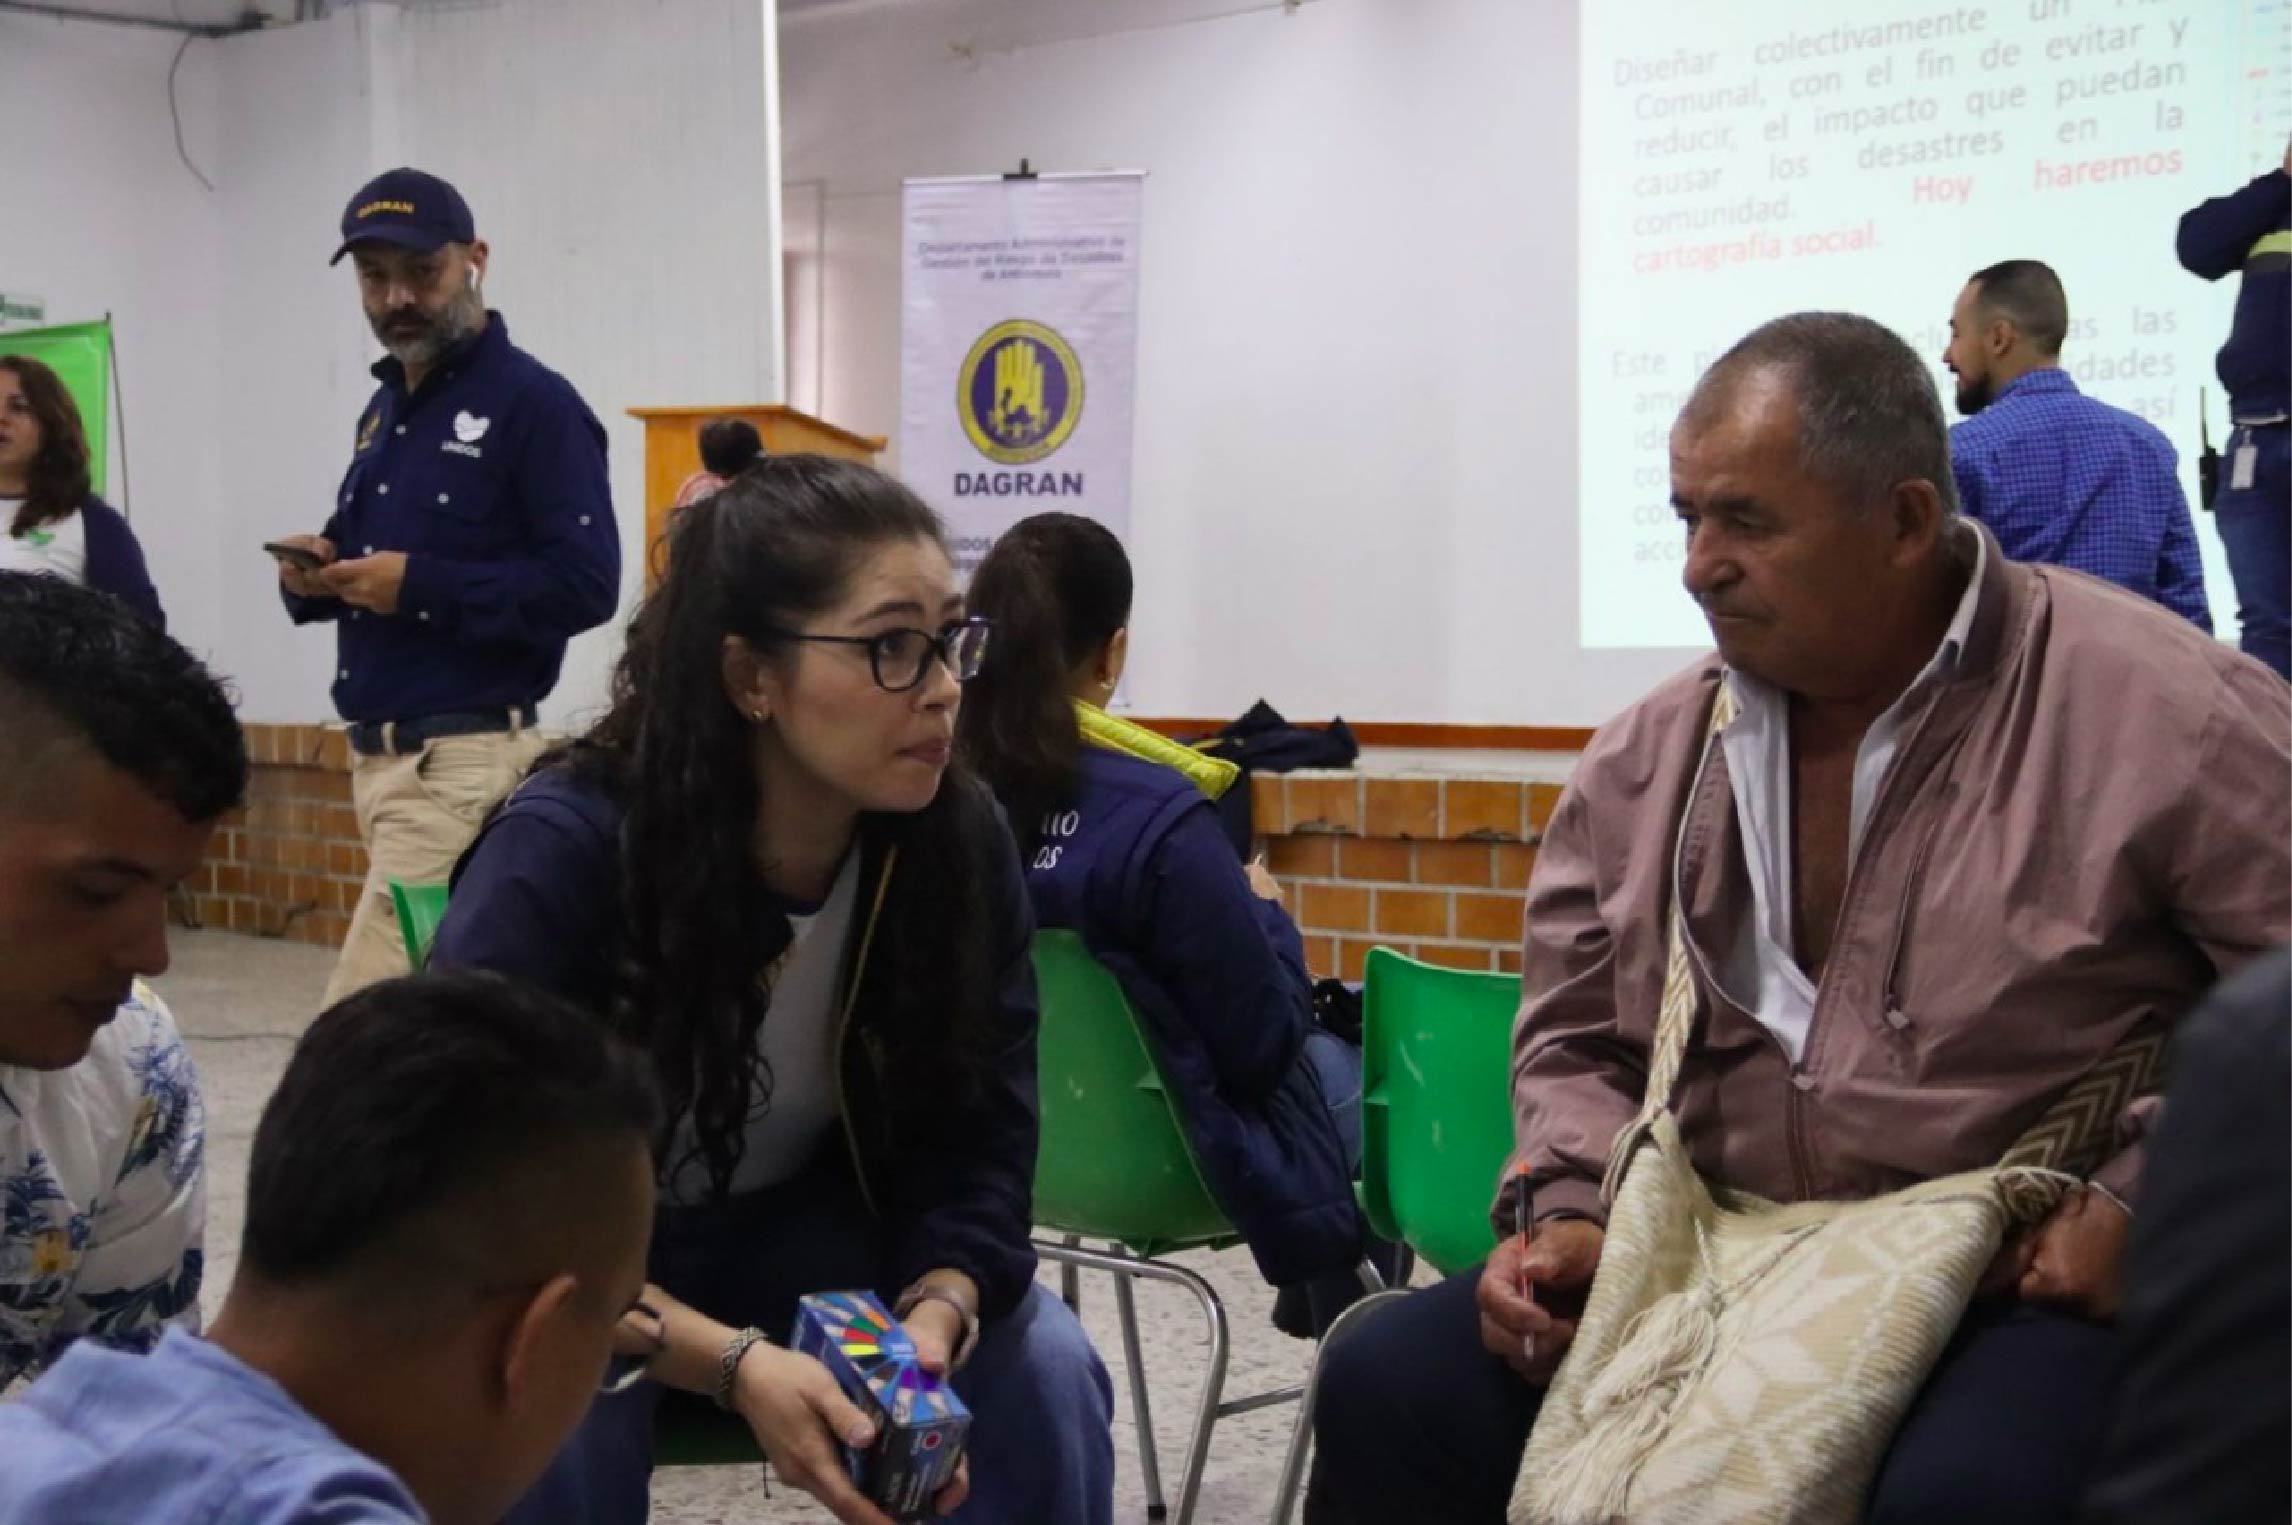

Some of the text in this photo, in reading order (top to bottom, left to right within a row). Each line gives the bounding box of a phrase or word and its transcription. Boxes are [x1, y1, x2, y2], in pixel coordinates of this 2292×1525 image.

[1613, 0, 2070, 88] Diseñar colectivamente un
[1634, 17, 2190, 120] Comunal, con el fin de evitar y
[1633, 100, 2185, 198] causar los desastres en la
[1634, 60, 2186, 158] reducir, el impacto que puedan
[1633, 148, 2183, 237] comunidad. Hoy haremos
[1633, 217, 1883, 273] cartografía social.
[1613, 349, 1667, 378] Este
[2132, 306, 2177, 335] las
[954, 472, 1084, 496] DAGRAN
